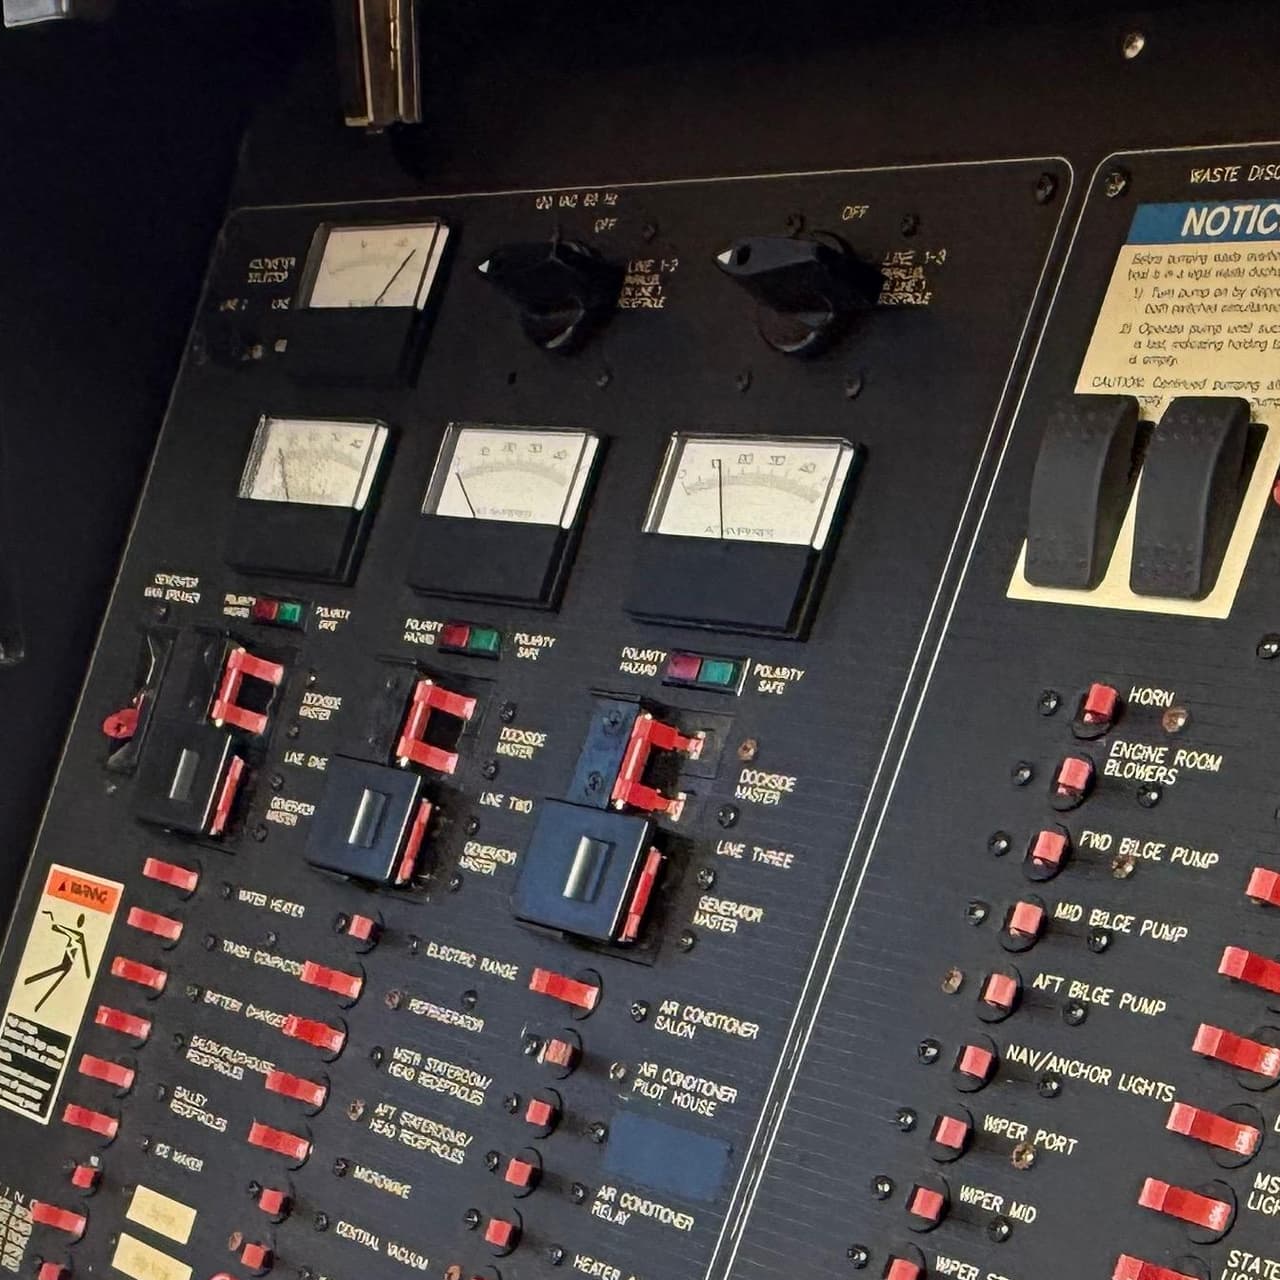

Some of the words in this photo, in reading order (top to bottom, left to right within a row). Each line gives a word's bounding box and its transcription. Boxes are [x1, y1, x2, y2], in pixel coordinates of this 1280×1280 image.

[1190, 165, 1241, 183] WASTE
[1128, 686, 1176, 707] HORN
[1104, 759, 1179, 785] BLOWERS
[1109, 740, 1169, 765] ENGINE
[1173, 749, 1224, 773] ROOM
[1079, 831, 1112, 851] FWD
[1119, 837, 1166, 861] BILGE
[1170, 847, 1220, 869] PUMP
[1089, 909, 1132, 933] BILGE
[1140, 920, 1188, 942] PUMP
[1032, 974, 1065, 993] AFT
[1068, 981, 1115, 1005] BILGE
[1119, 992, 1167, 1017] PUMP
[1006, 1044, 1112, 1087] NAV/ANCHOR
[1118, 1073, 1177, 1104] LIGHTS
[1034, 1128, 1079, 1157] PORT
[1008, 1201, 1037, 1224] MID
